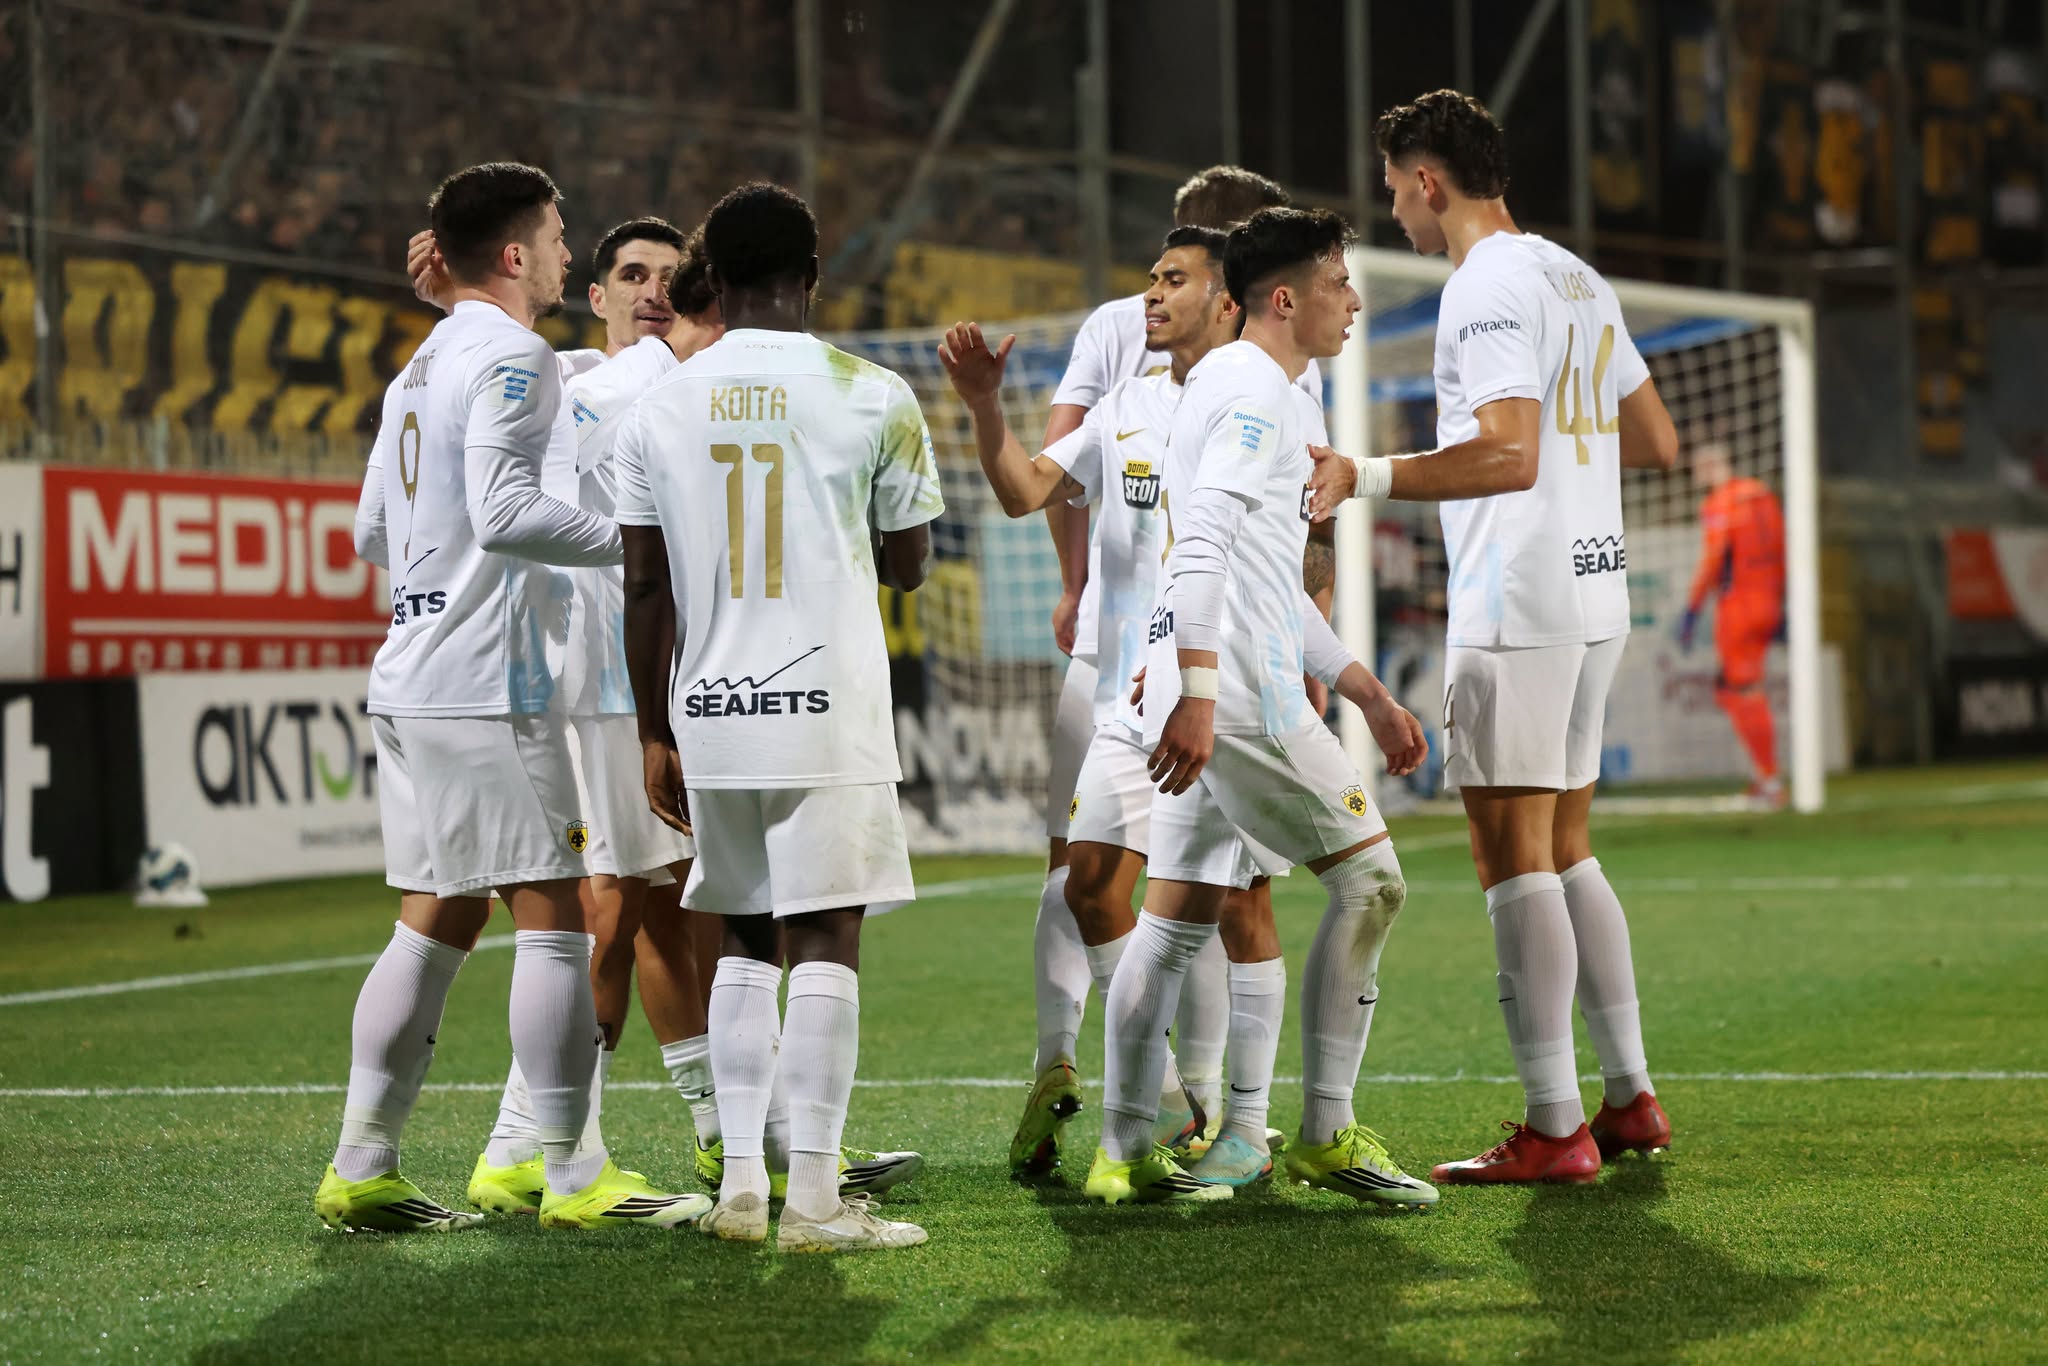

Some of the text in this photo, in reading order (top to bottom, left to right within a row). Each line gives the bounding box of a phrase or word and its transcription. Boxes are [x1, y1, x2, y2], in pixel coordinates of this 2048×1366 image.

[1470, 319, 1521, 336] Piraeus
[710, 385, 787, 422] KOITA
[1127, 462, 1150, 474] pame
[399, 411, 421, 561] 9
[709, 443, 784, 599] 11
[1572, 548, 1627, 577] SEAJE
[684, 689, 830, 718] SEAJETS
